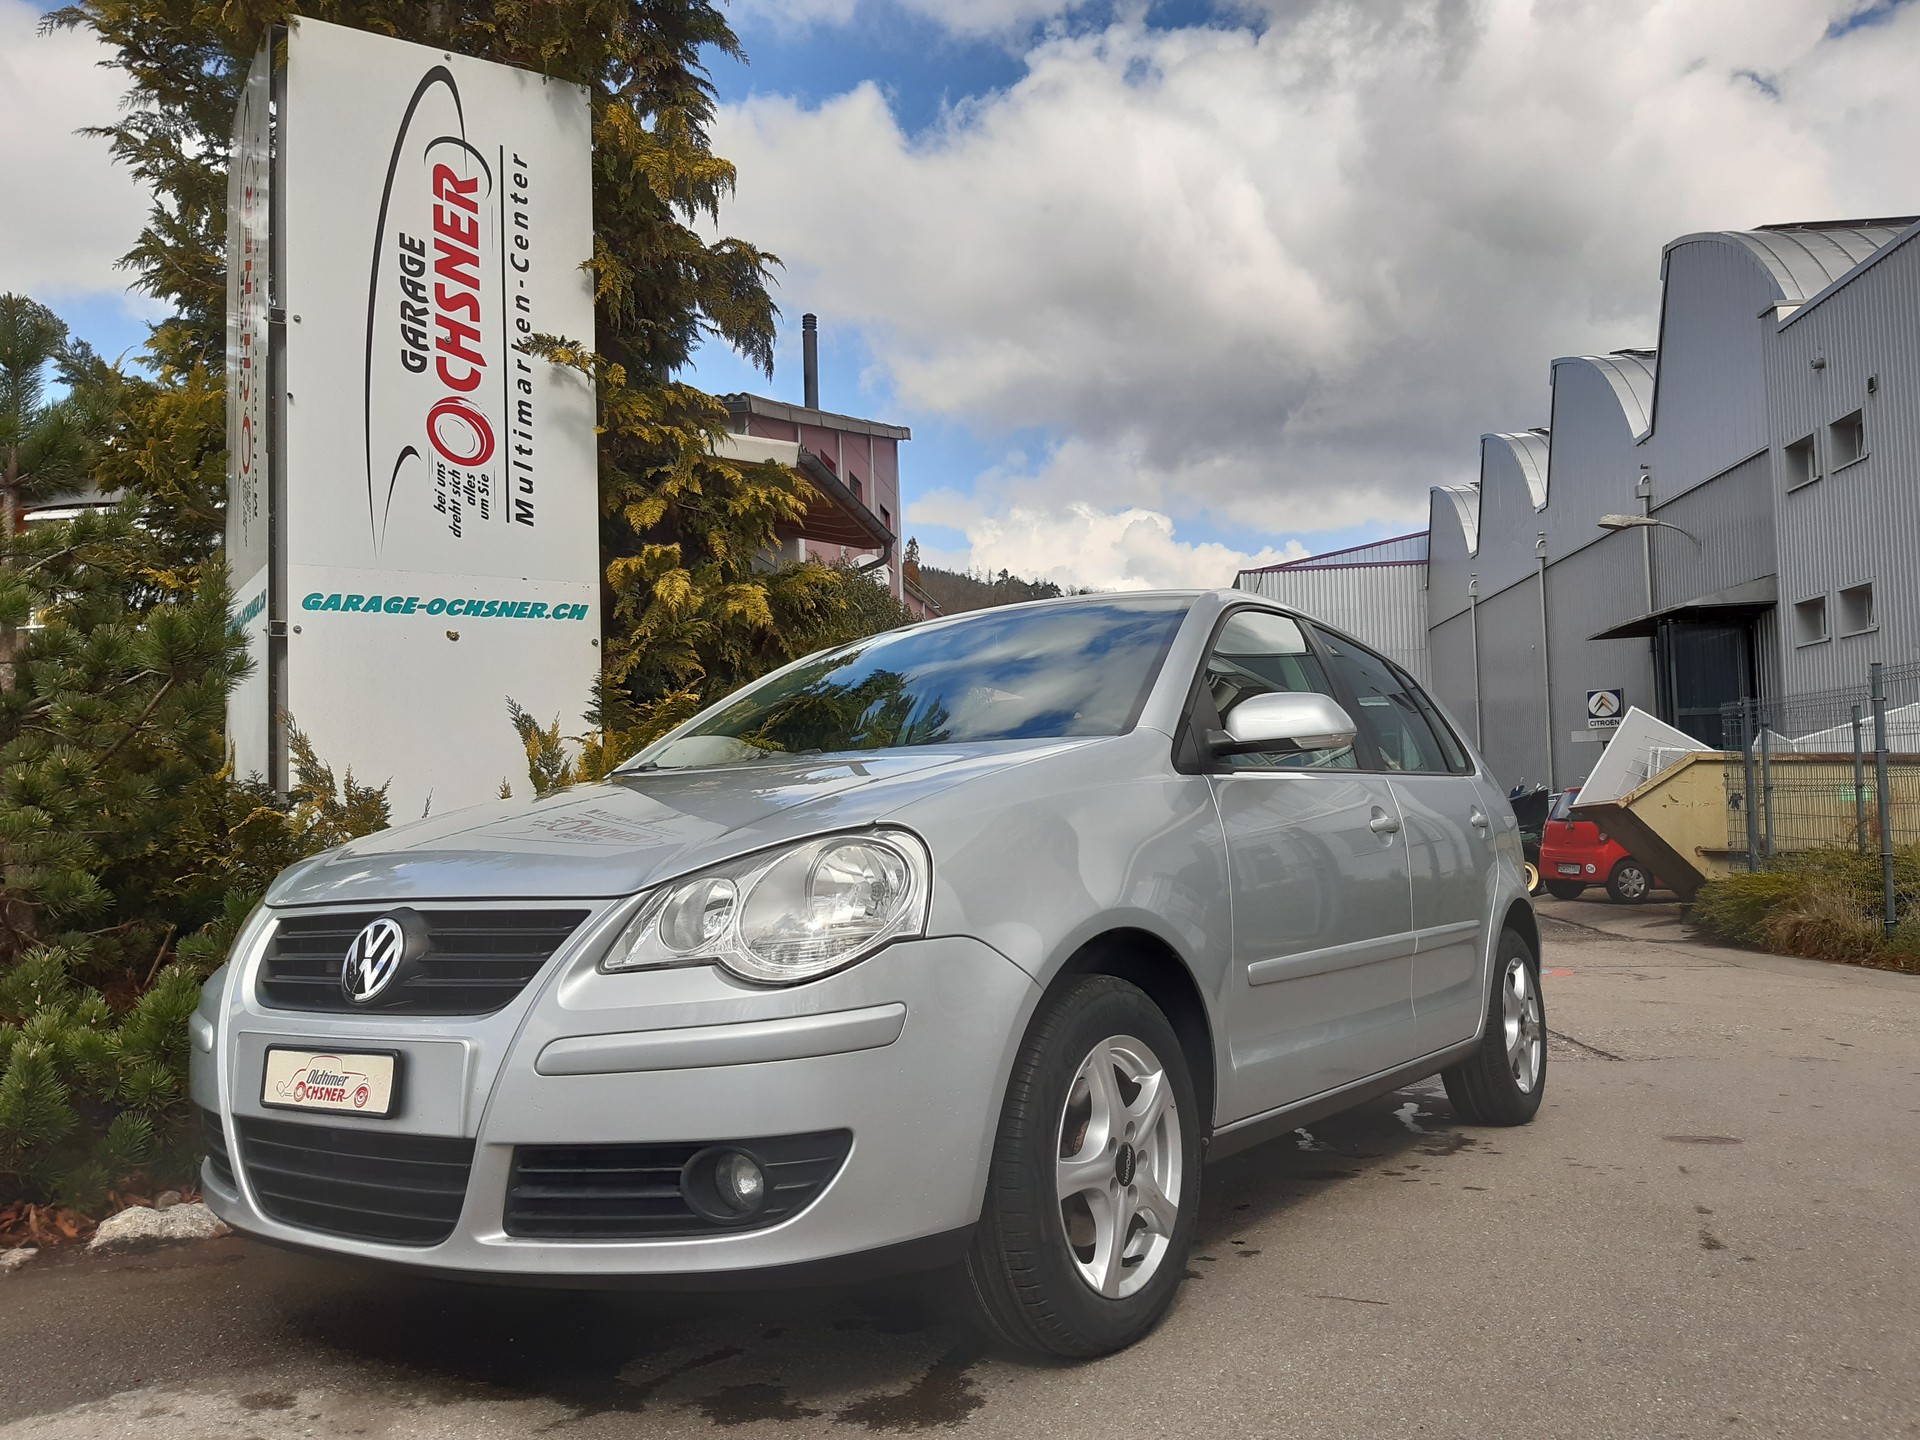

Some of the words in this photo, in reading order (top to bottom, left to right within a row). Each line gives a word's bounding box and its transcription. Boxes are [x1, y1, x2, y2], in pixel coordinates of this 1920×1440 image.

[399, 232, 430, 374] GARAGE
[437, 461, 446, 487] uns
[448, 469, 461, 497] sich
[477, 474, 489, 496] Sie
[433, 488, 446, 514] bei
[463, 473, 476, 506] alles
[448, 499, 461, 538] dreht
[481, 498, 489, 520] um
[301, 592, 589, 621] GARAGE-OCHSNER.CH
[306, 1069, 349, 1087] Oldtimer
